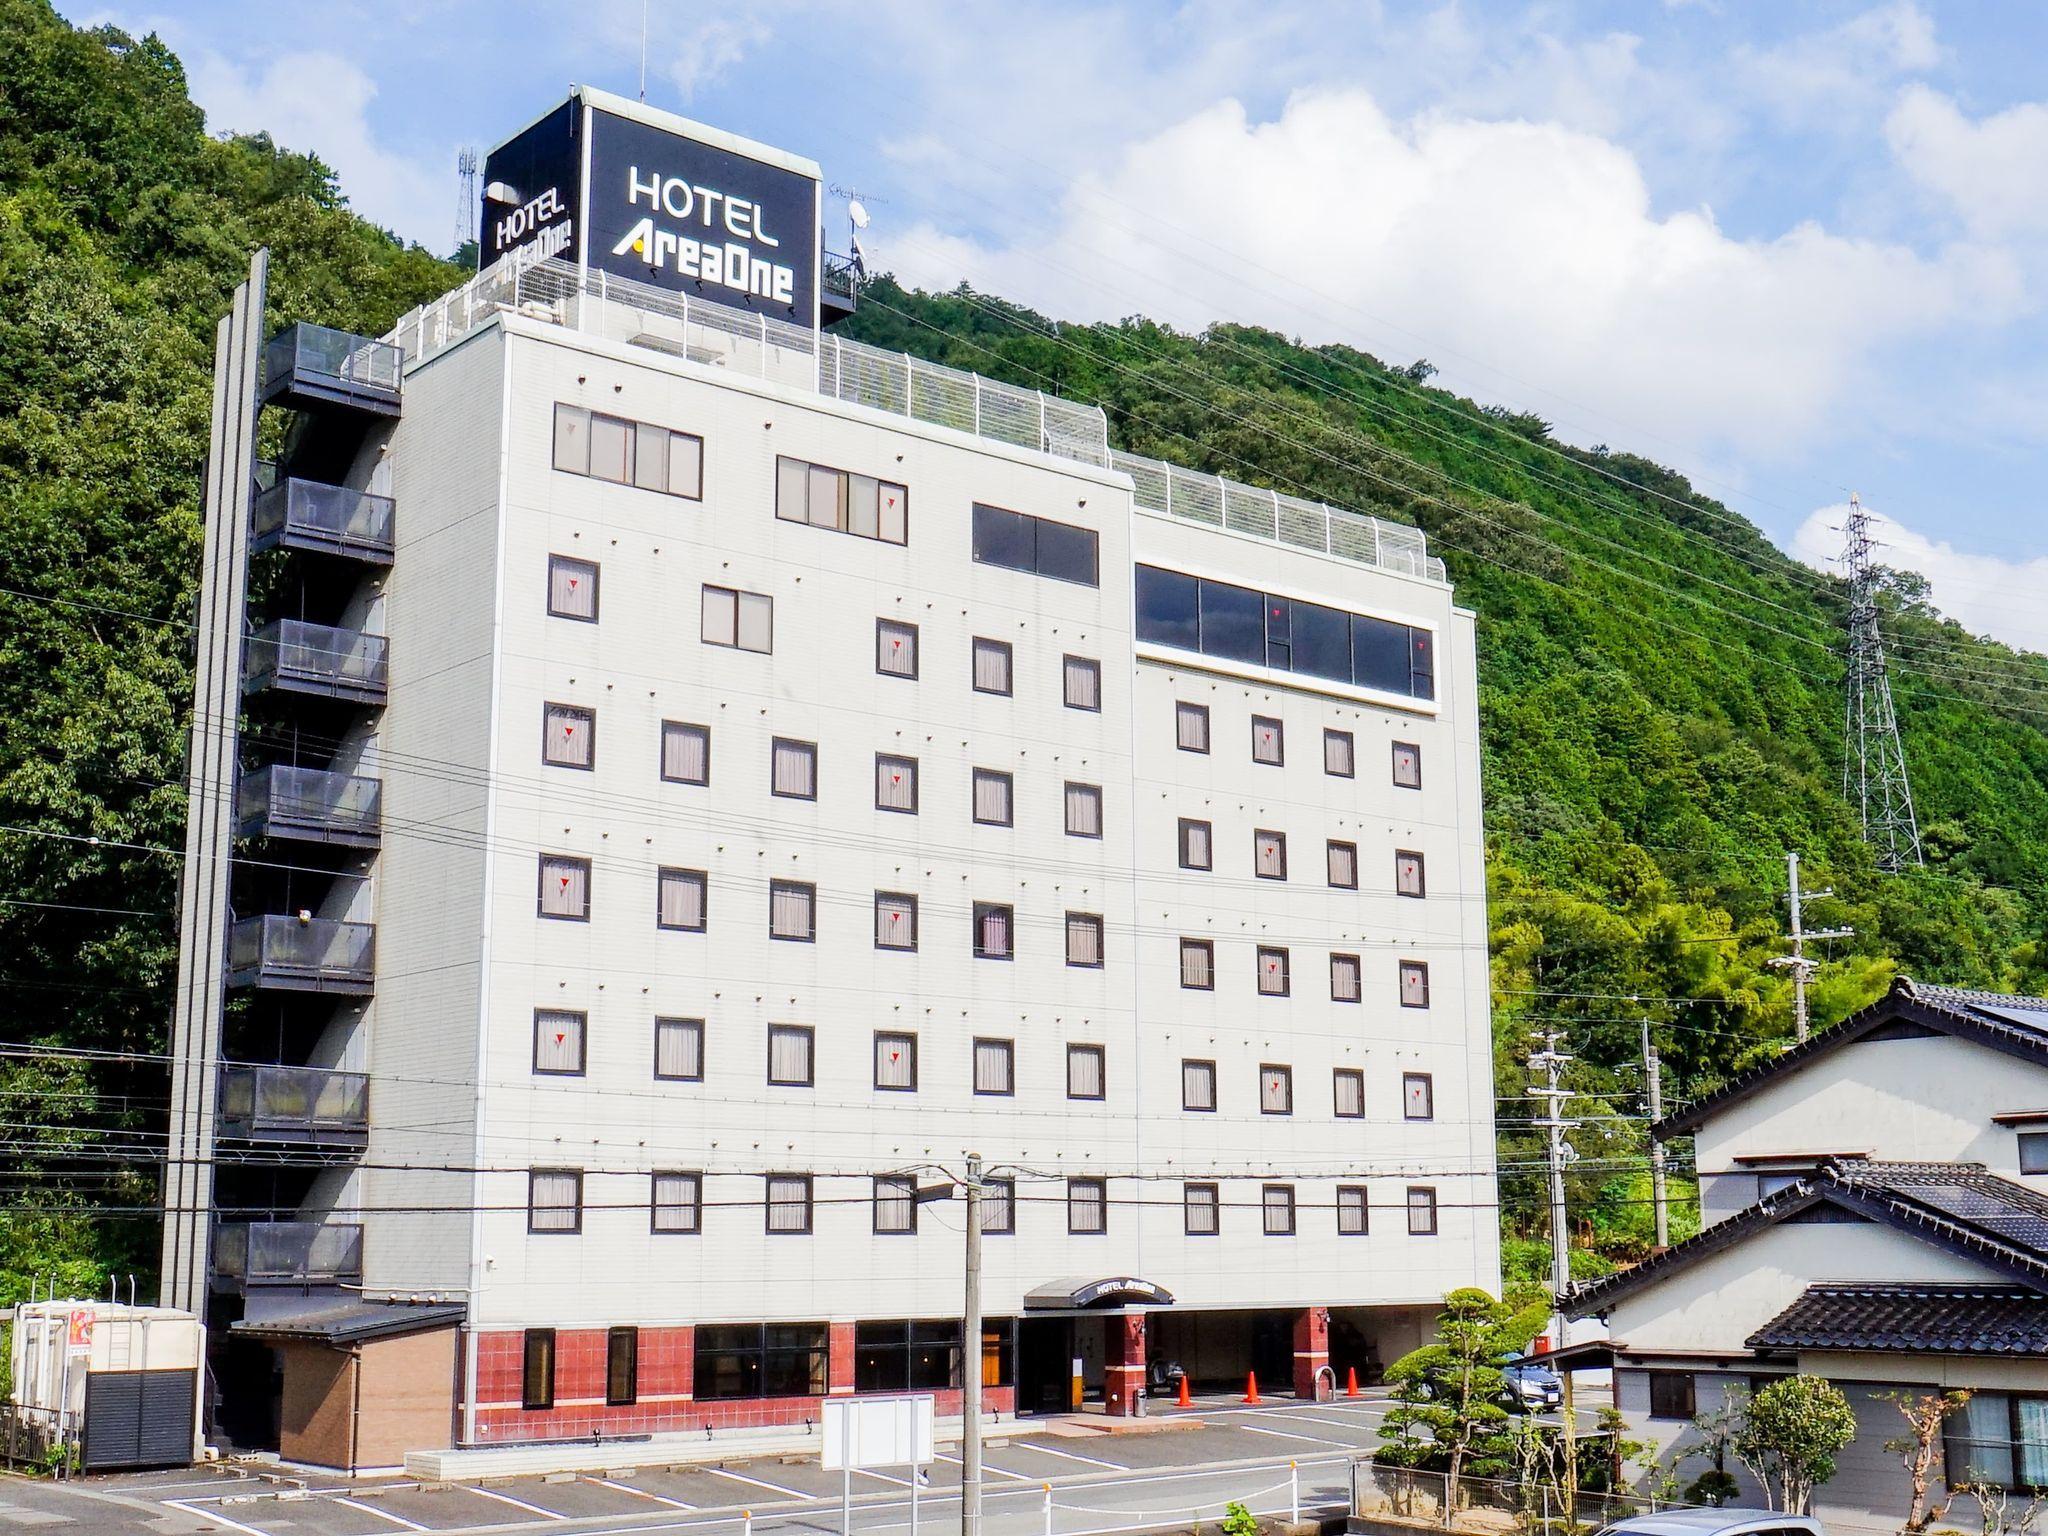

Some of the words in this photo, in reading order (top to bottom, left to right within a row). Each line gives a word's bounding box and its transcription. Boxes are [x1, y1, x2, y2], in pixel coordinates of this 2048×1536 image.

[496, 187, 565, 250] HOTEL
[629, 166, 779, 247] HOTEL
[612, 218, 793, 304] AreaOne
[1096, 1281, 1124, 1295] HOTEL
